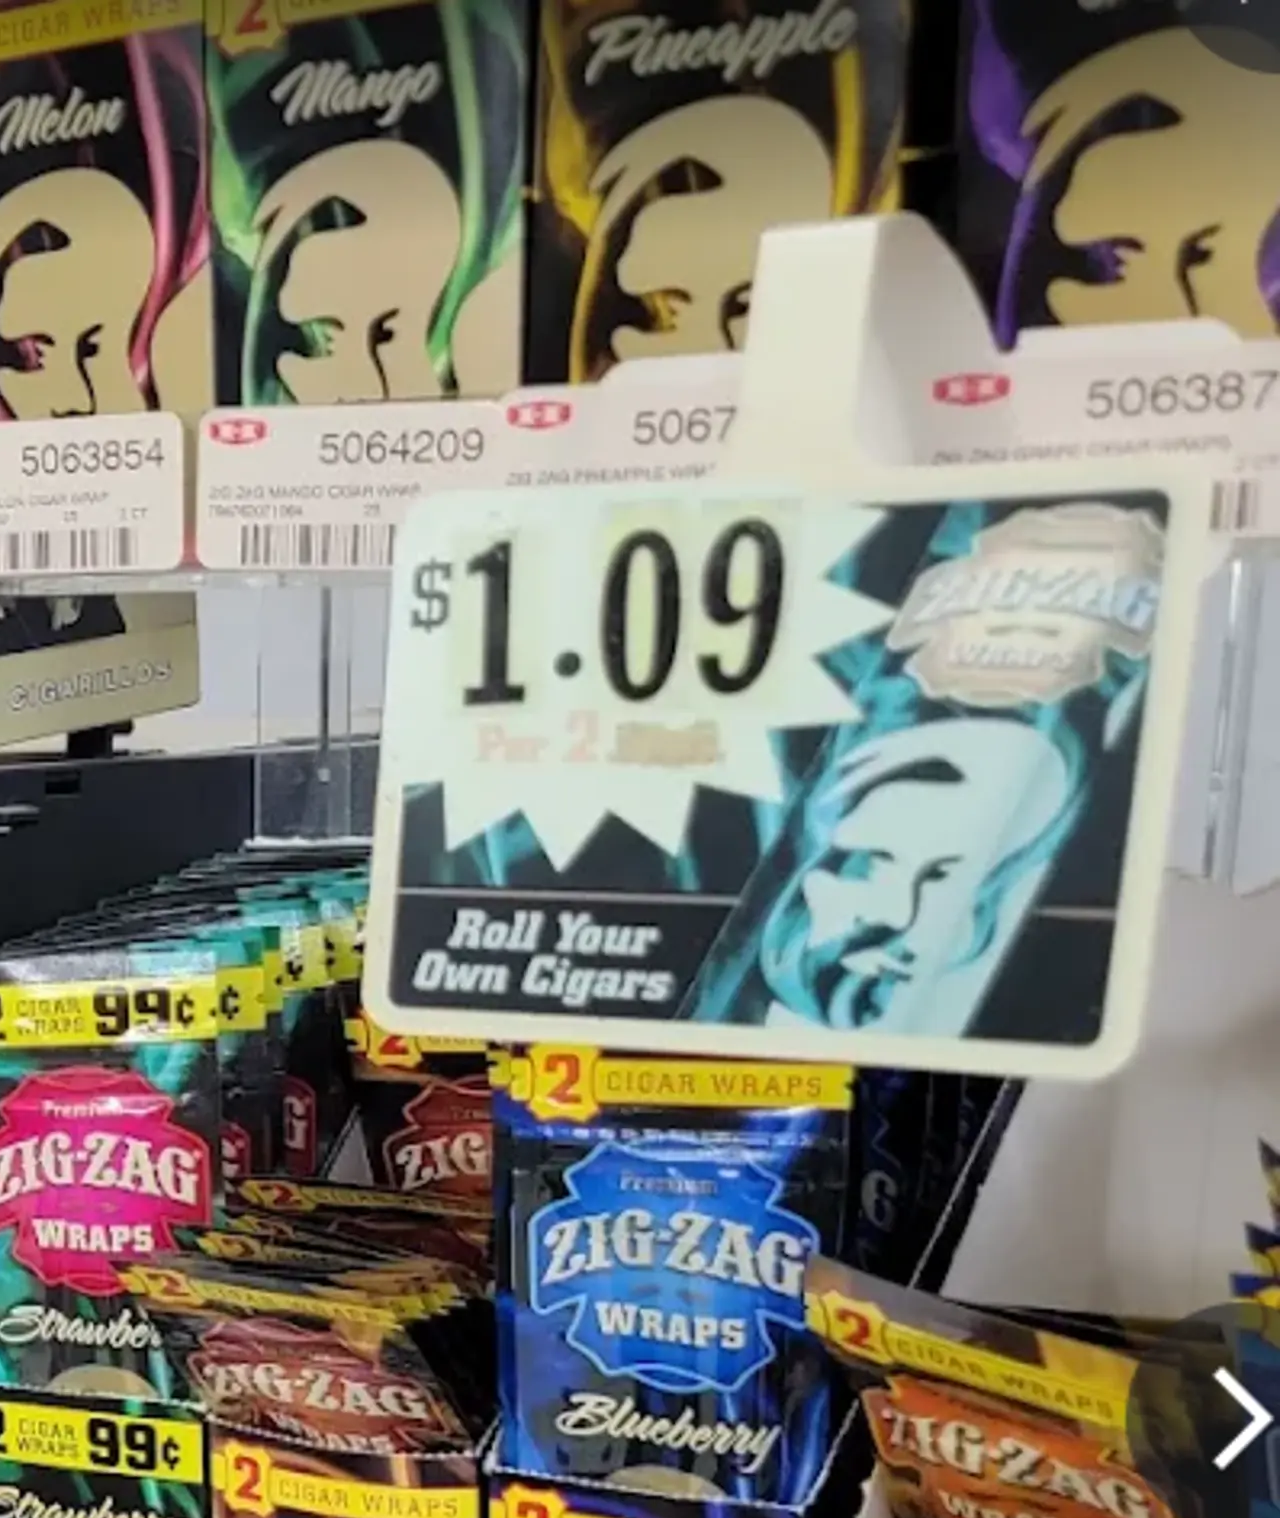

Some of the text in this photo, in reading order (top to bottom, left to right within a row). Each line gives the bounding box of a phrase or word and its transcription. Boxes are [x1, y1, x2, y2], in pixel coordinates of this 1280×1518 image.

[584, 6, 860, 86] Pineapple
[270, 60, 442, 127] Mango
[1085, 370, 1280, 421] 506387
[20, 438, 166, 478] 5063854
[319, 426, 486, 467] 5064209
[410, 516, 788, 706] $1.09
[9, 659, 174, 714] CIGARILLOS
[446, 909, 660, 957] Roll Your
[414, 949, 674, 1004] Own Cigars
[15, 998, 83, 1017] CIGAR
[92, 985, 195, 1037] 99¢
[545, 1052, 824, 1104] 2 CIGAR WRAPS
[33, 1218, 154, 1254] WRAPS
[542, 1208, 812, 1296] ZIG-ZAG
[593, 1301, 749, 1351] WRAPS
[203, 1362, 428, 1420] ZIG-ZAG
[15, 1437, 80, 1461] WRAPS
[17, 1420, 76, 1441] CIGAR
[87, 1417, 181, 1473] 99¢
[555, 1392, 784, 1474] Blueberry
[233, 1449, 262, 1501] 2
[278, 1480, 350, 1512] CIGAR
